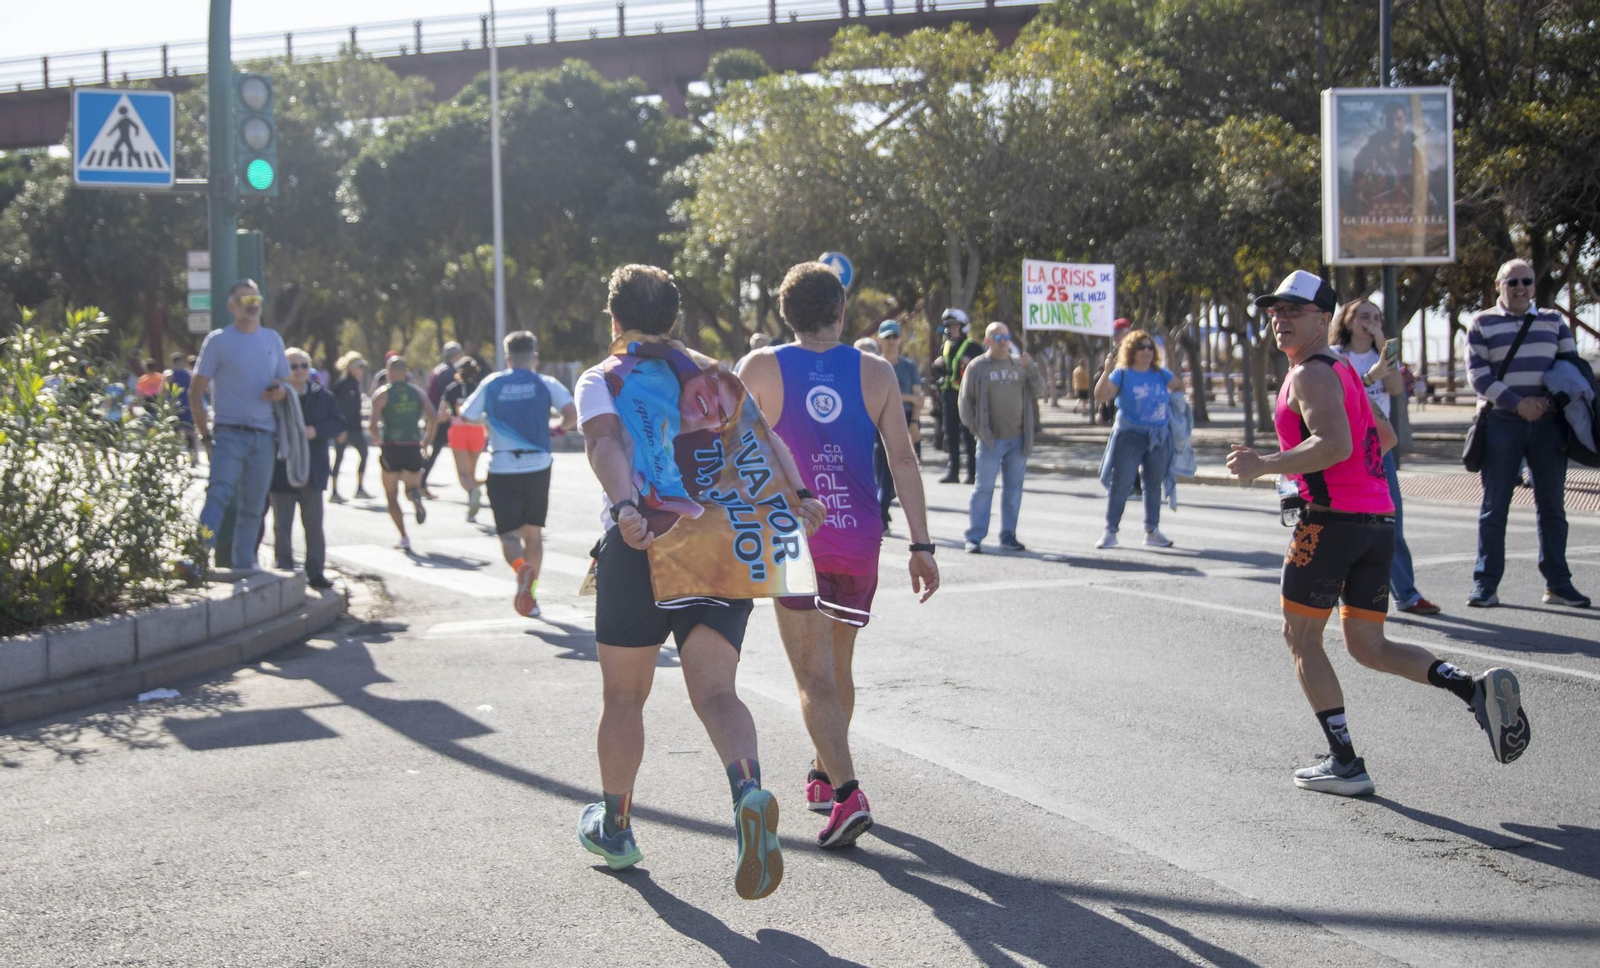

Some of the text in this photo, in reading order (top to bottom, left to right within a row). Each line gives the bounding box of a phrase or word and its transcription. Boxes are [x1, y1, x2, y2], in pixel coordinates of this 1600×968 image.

[1027, 265, 1112, 287] LA CRISIS DE
[1027, 284, 1107, 302] LOS 25 ME HIZO
[1029, 303, 1092, 328] RUNNER
[823, 443, 842, 454] C.D.
[814, 472, 848, 490] AL
[735, 429, 801, 564] "VA POR
[818, 493, 852, 509] ME
[709, 490, 767, 581] JLIO"
